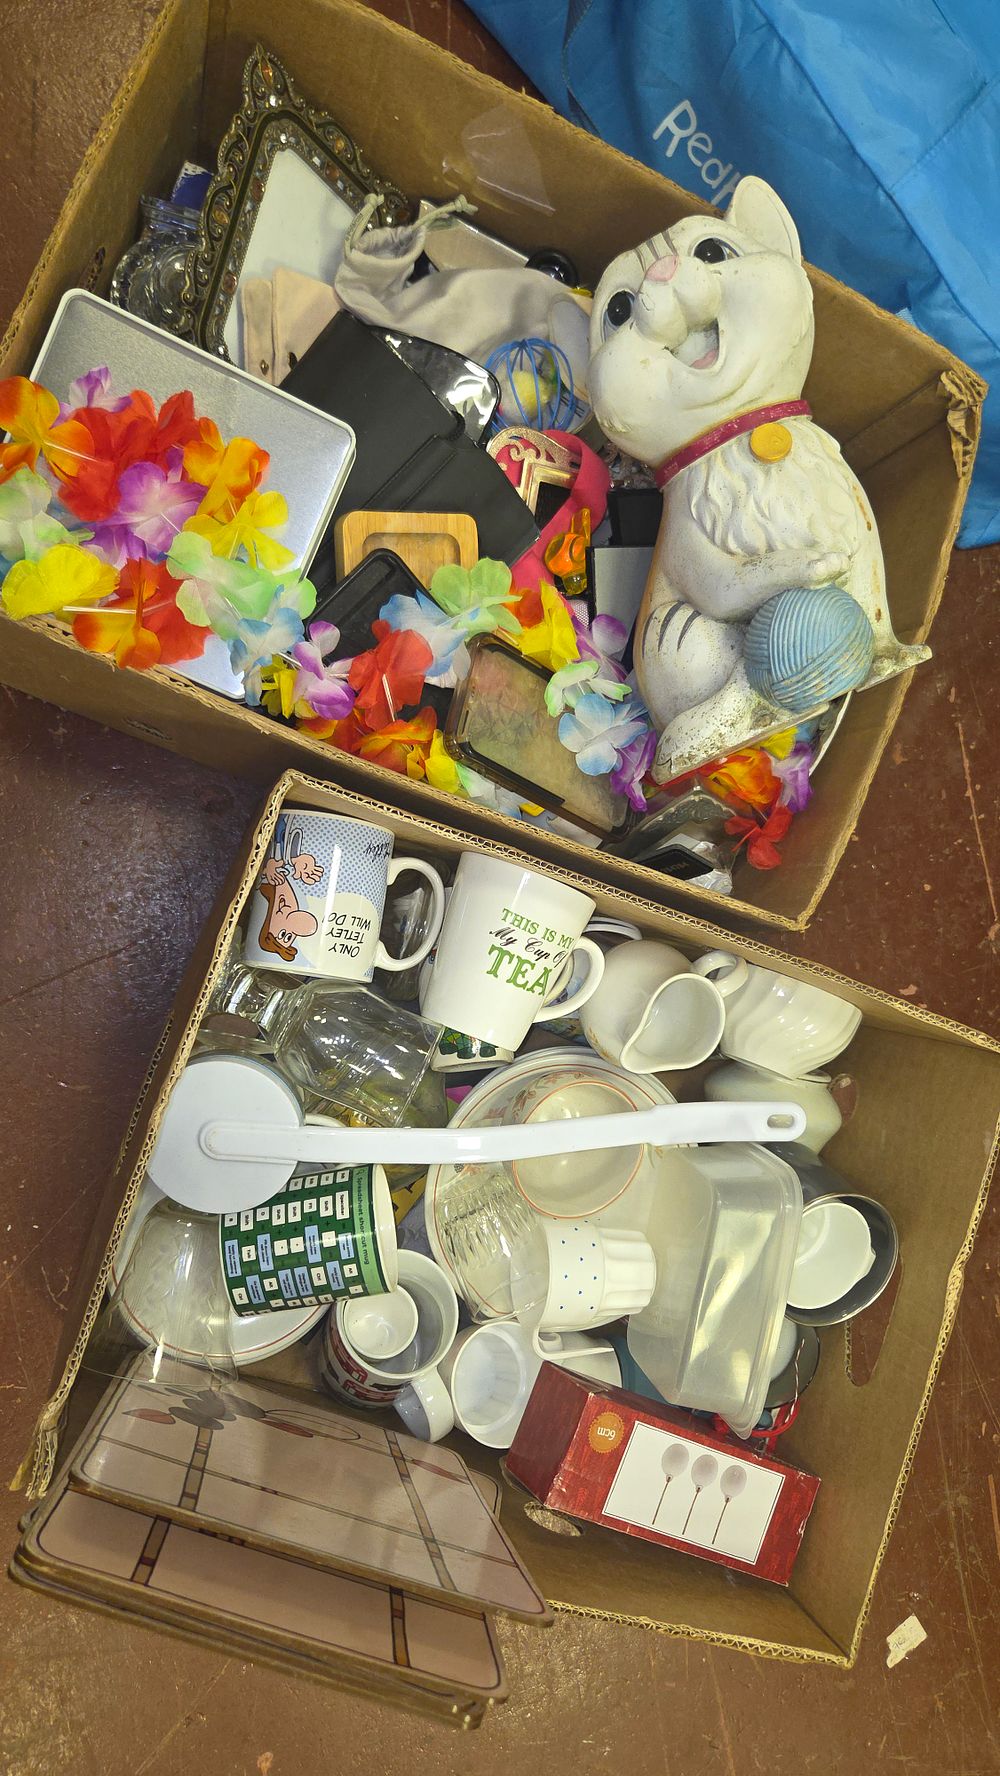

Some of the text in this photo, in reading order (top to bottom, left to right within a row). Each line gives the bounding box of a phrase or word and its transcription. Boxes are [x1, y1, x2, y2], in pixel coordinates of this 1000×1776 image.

[325, 927, 365, 944] TETLEY
[351, 916, 371, 931] WILL
[501, 907, 575, 950] THIS IS MY
[328, 942, 360, 958] ONLY
[488, 926, 518, 947] My
[524, 937, 551, 962] Cup
[486, 943, 553, 997] TEA
[355, 1177, 364, 1216] Spreadsheet
[359, 1217, 368, 1249] shorcut
[597, 1426, 616, 1441] 6cm
